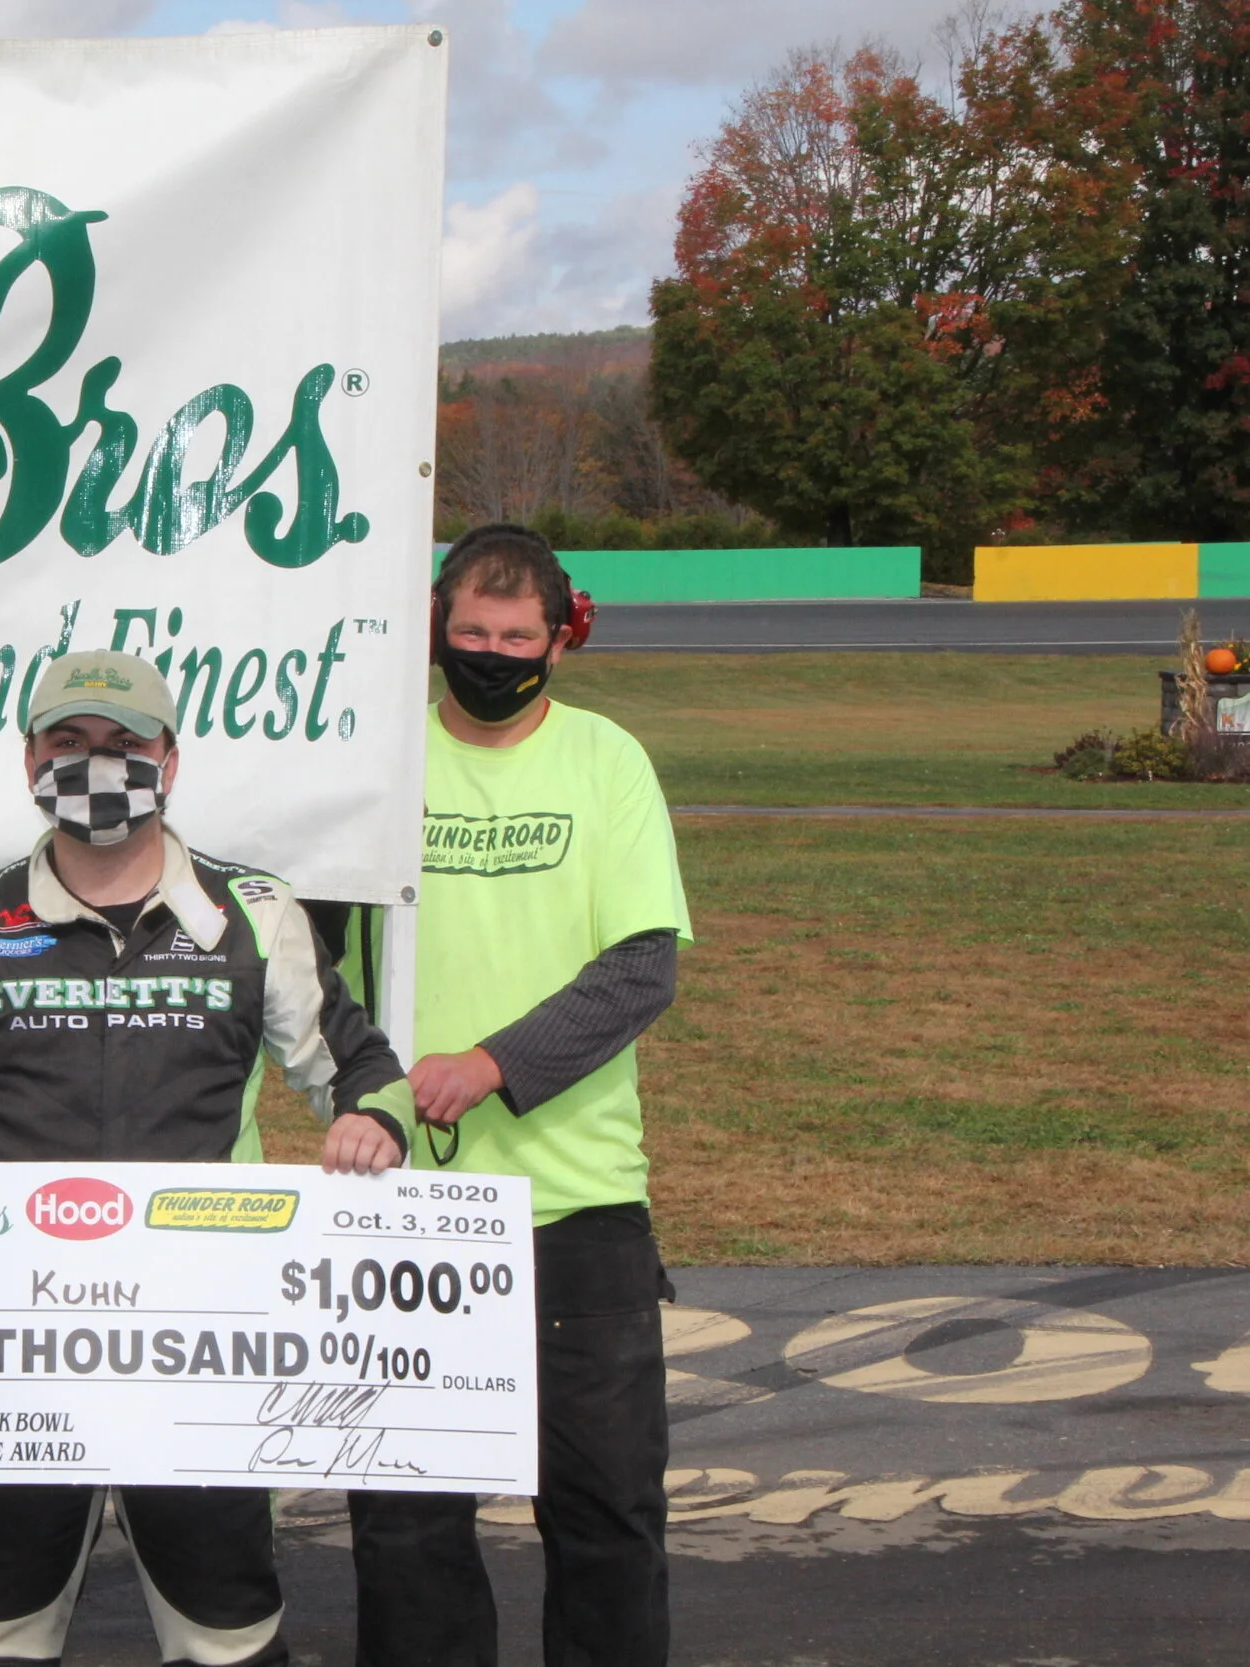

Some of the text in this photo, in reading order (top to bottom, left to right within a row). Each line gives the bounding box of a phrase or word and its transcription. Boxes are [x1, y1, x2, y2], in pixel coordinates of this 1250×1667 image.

[422, 823, 561, 852] UNDER ROAD
[143, 953, 228, 963] THIRTY TWO SIGNS
[9, 1013, 206, 1031] AUTO PARTS
[429, 1183, 499, 1203] 5020
[34, 1194, 126, 1226] Hood
[157, 1196, 287, 1213] THUNDER ROAD
[332, 1210, 506, 1236] Oct. 3, 2020
[31, 1269, 141, 1308] KUHN
[441, 1375, 517, 1393] DOLLARS
[14, 1411, 75, 1432] BOWL
[8, 1441, 87, 1462] AWARD
